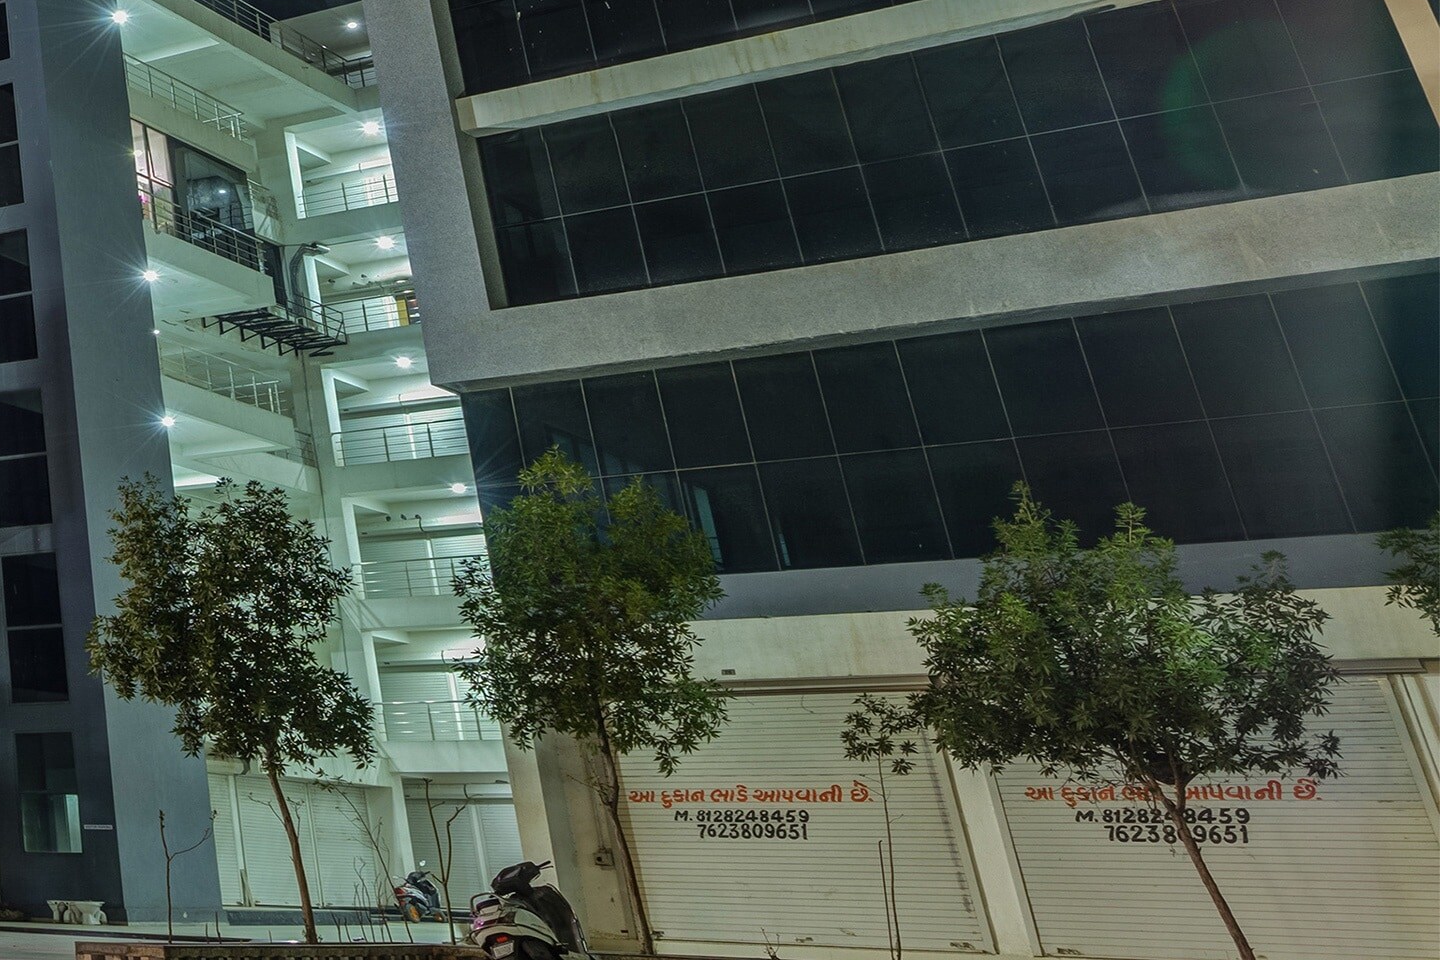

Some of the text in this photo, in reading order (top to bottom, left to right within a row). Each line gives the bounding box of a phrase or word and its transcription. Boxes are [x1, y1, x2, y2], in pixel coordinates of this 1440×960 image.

[628, 791, 655, 802] આ
[661, 789, 705, 809] દુકાન
[710, 784, 748, 802] ભાડે
[753, 784, 842, 802] આપવાની
[1024, 786, 1054, 801] આ
[696, 810, 809, 823] 8128248459
[697, 823, 808, 840] 7623809651
[1104, 824, 1249, 844] 762389651
